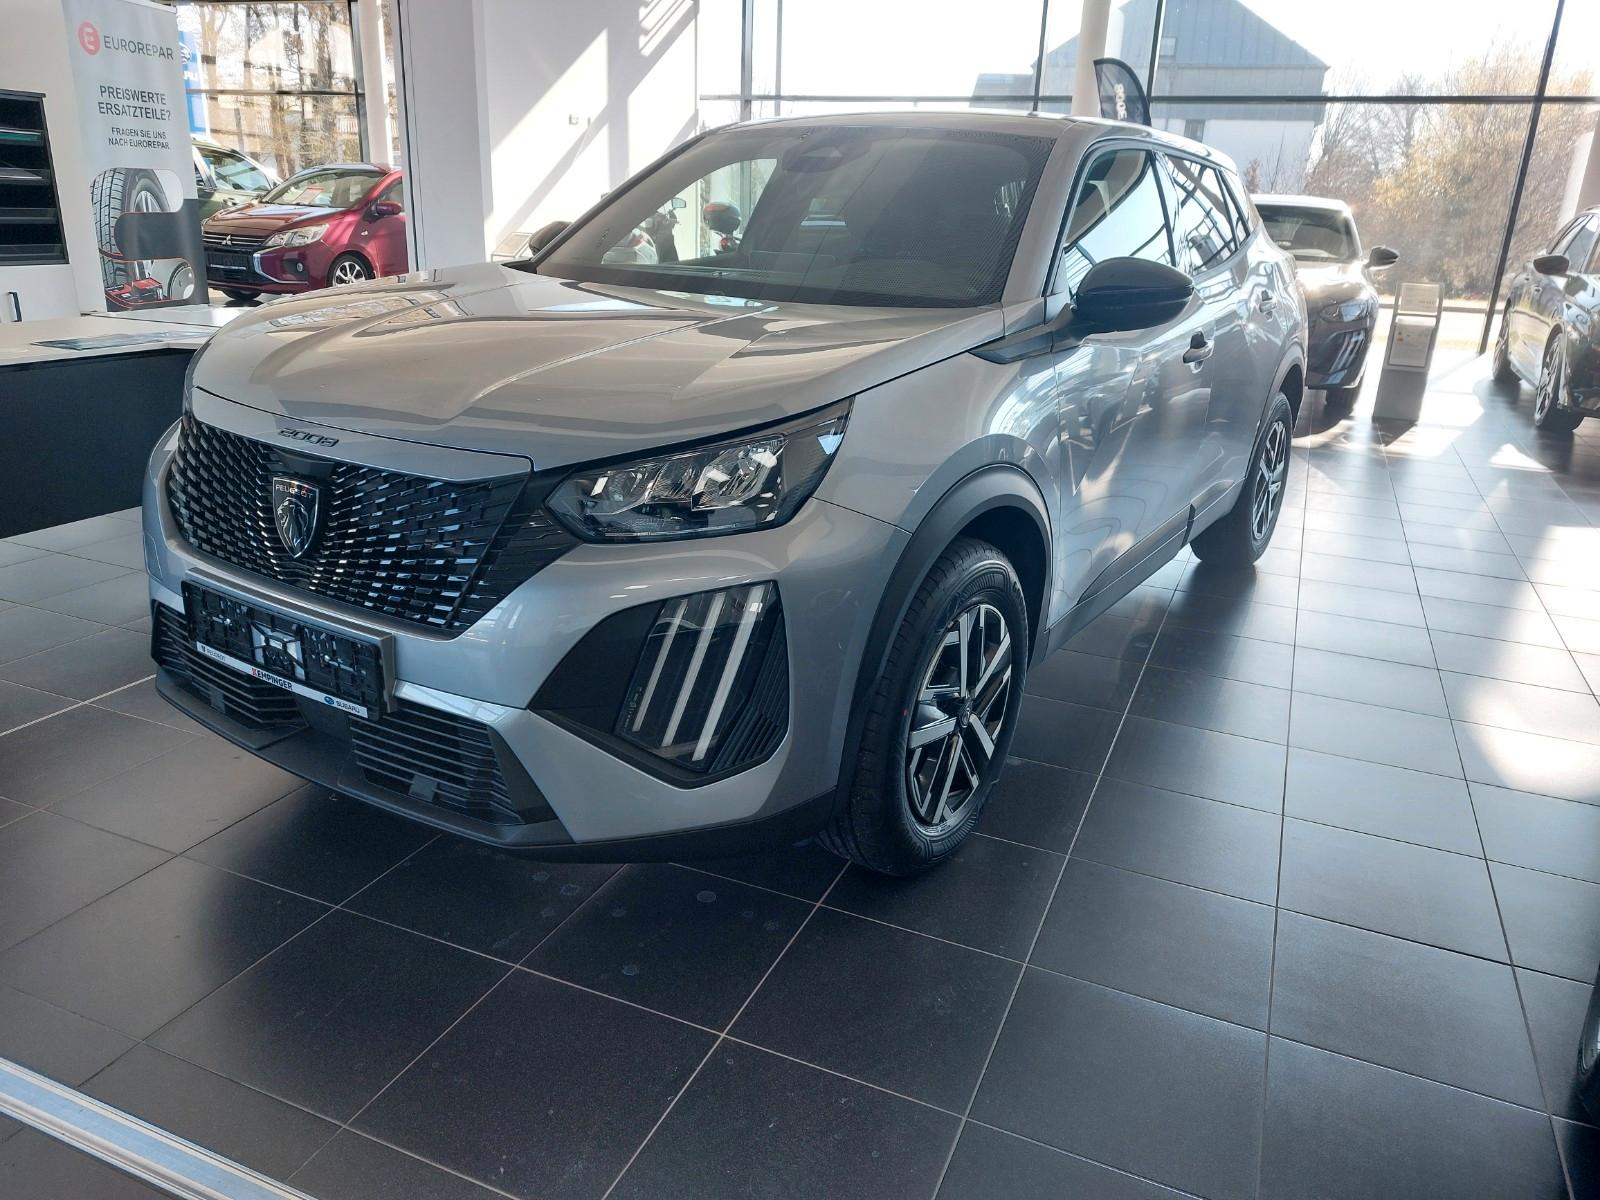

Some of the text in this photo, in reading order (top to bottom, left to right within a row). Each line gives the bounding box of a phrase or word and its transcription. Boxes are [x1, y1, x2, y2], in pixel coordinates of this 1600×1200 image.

[103, 35, 174, 60] EUROREPAR
[99, 85, 167, 105] PREISWERTE
[98, 101, 171, 121] ERSATZTEILE?
[111, 126, 167, 140] FRAGEN SIE UNS
[108, 137, 170, 150] NACH EUROREPAR
[278, 427, 340, 448] 2008
[275, 483, 313, 499] PEUGEOT
